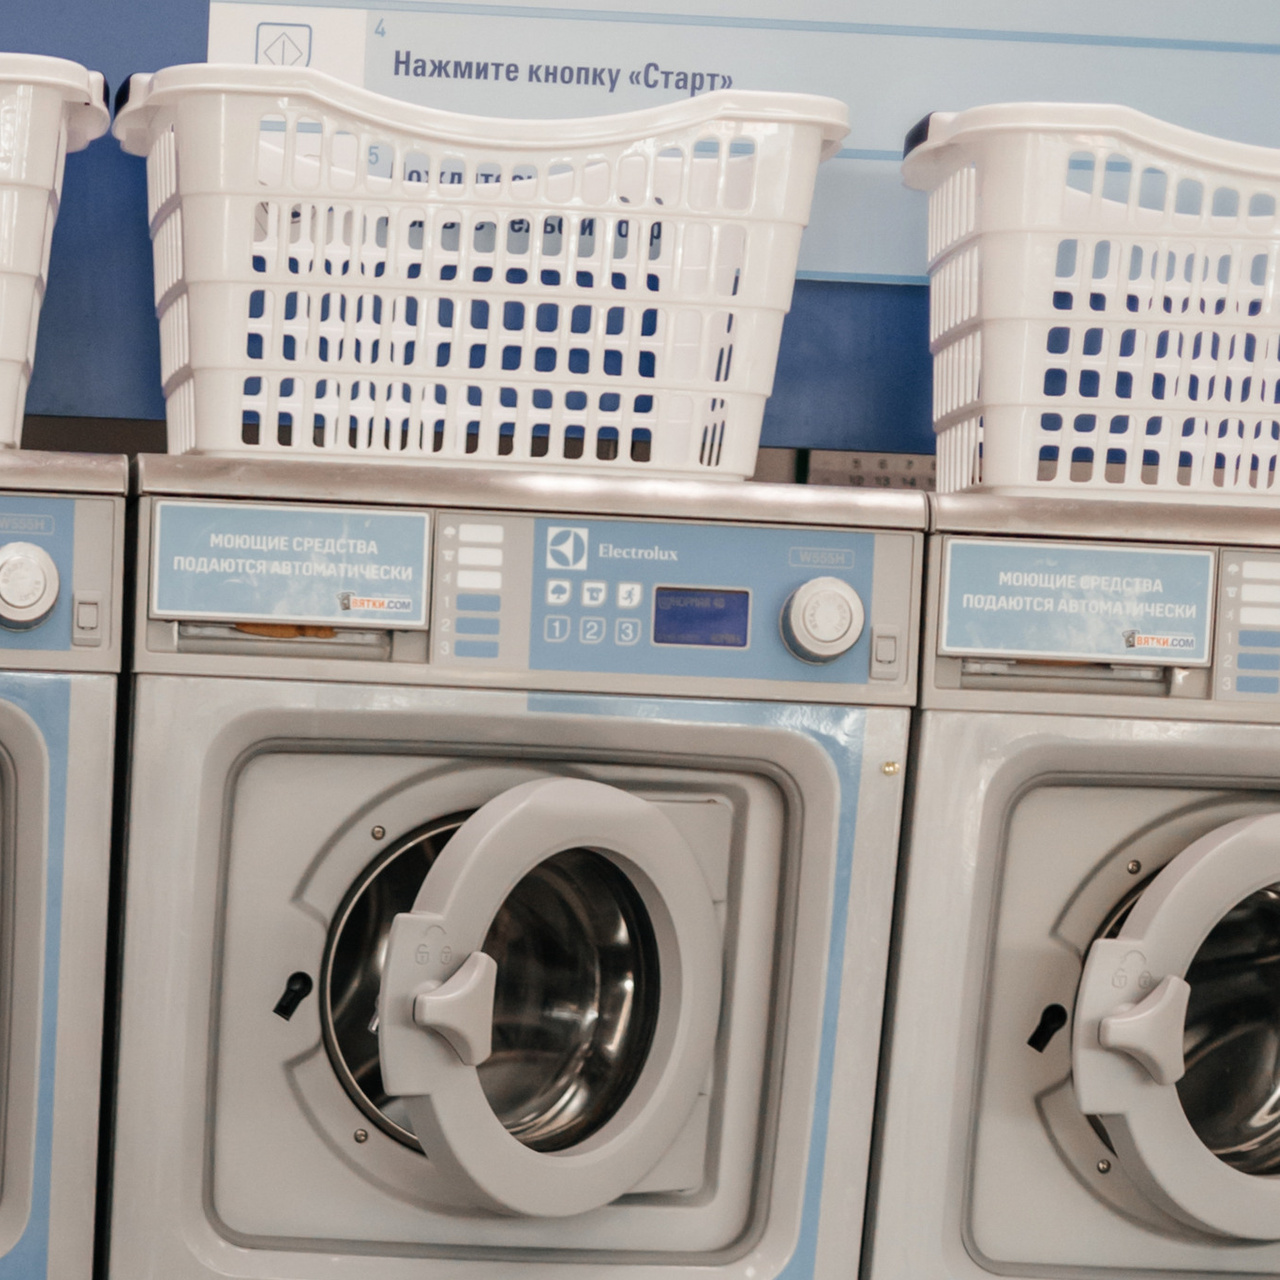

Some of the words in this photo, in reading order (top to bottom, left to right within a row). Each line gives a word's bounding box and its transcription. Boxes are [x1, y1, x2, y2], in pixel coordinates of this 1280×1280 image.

[374, 18, 386, 37] 4
[393, 50, 520, 82] Нажмите
[527, 64, 621, 93] кнопку
[628, 62, 733, 97] «Старт»
[368, 145, 379, 165] 5
[209, 533, 289, 552] МОЮЩИЕ
[292, 536, 378, 555] СРЕДСТВА
[598, 543, 678, 561] Electrolux
[173, 556, 266, 574] ПОДАЮТСЯ
[269, 560, 413, 580] АВТОМАТИЧЕСКИ
[998, 571, 1076, 590] МОЮЩИЕ
[1079, 575, 1163, 593] СРЕДСТВА
[962, 594, 1054, 612] ПОДАЮТСЯ
[1057, 599, 1197, 619] АВТОМАТИЧЕСКИ
[551, 620, 561, 637] 1
[585, 621, 599, 639] 2
[621, 623, 634, 641] 3
